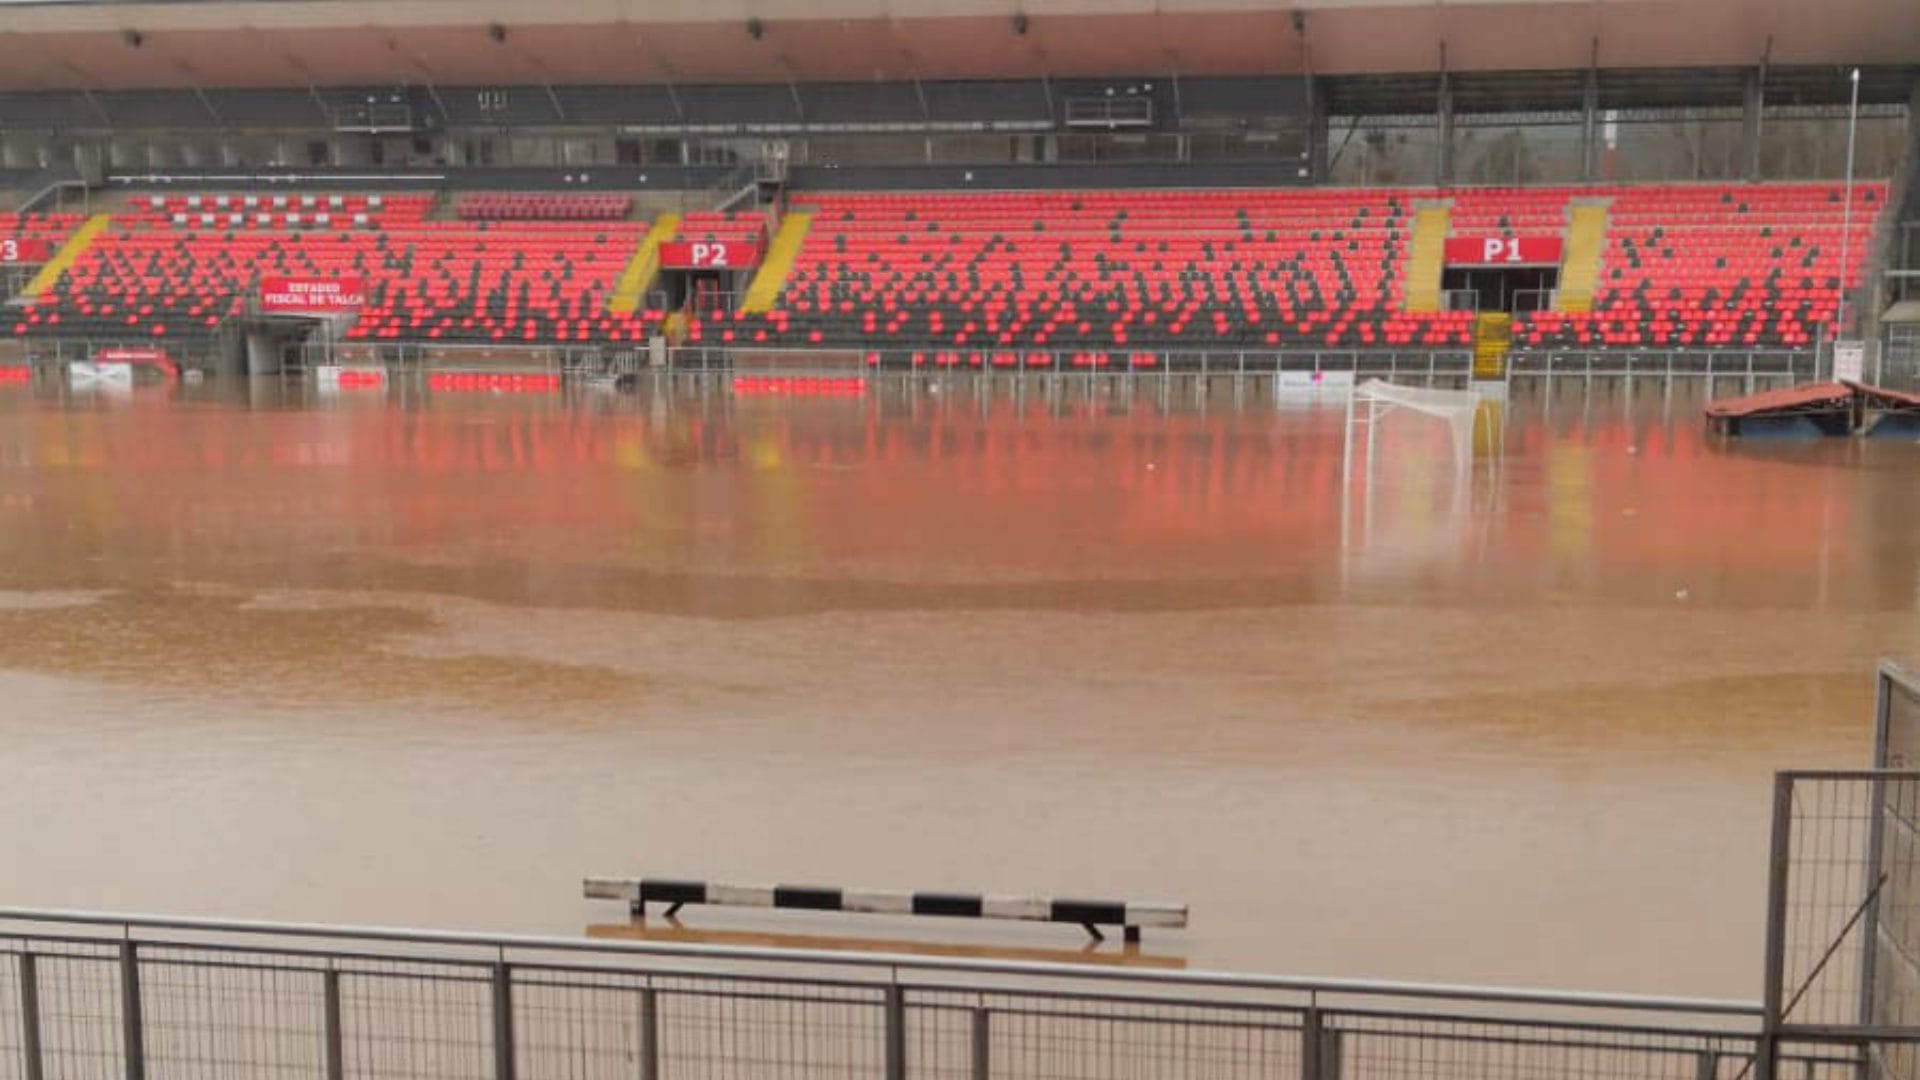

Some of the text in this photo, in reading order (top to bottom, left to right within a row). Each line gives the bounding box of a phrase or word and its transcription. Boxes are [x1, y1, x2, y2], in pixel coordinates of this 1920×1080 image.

[0, 240, 18, 260] 3
[692, 244, 727, 265] P2
[1484, 238, 1522, 261] P1
[309, 294, 325, 305] DE
